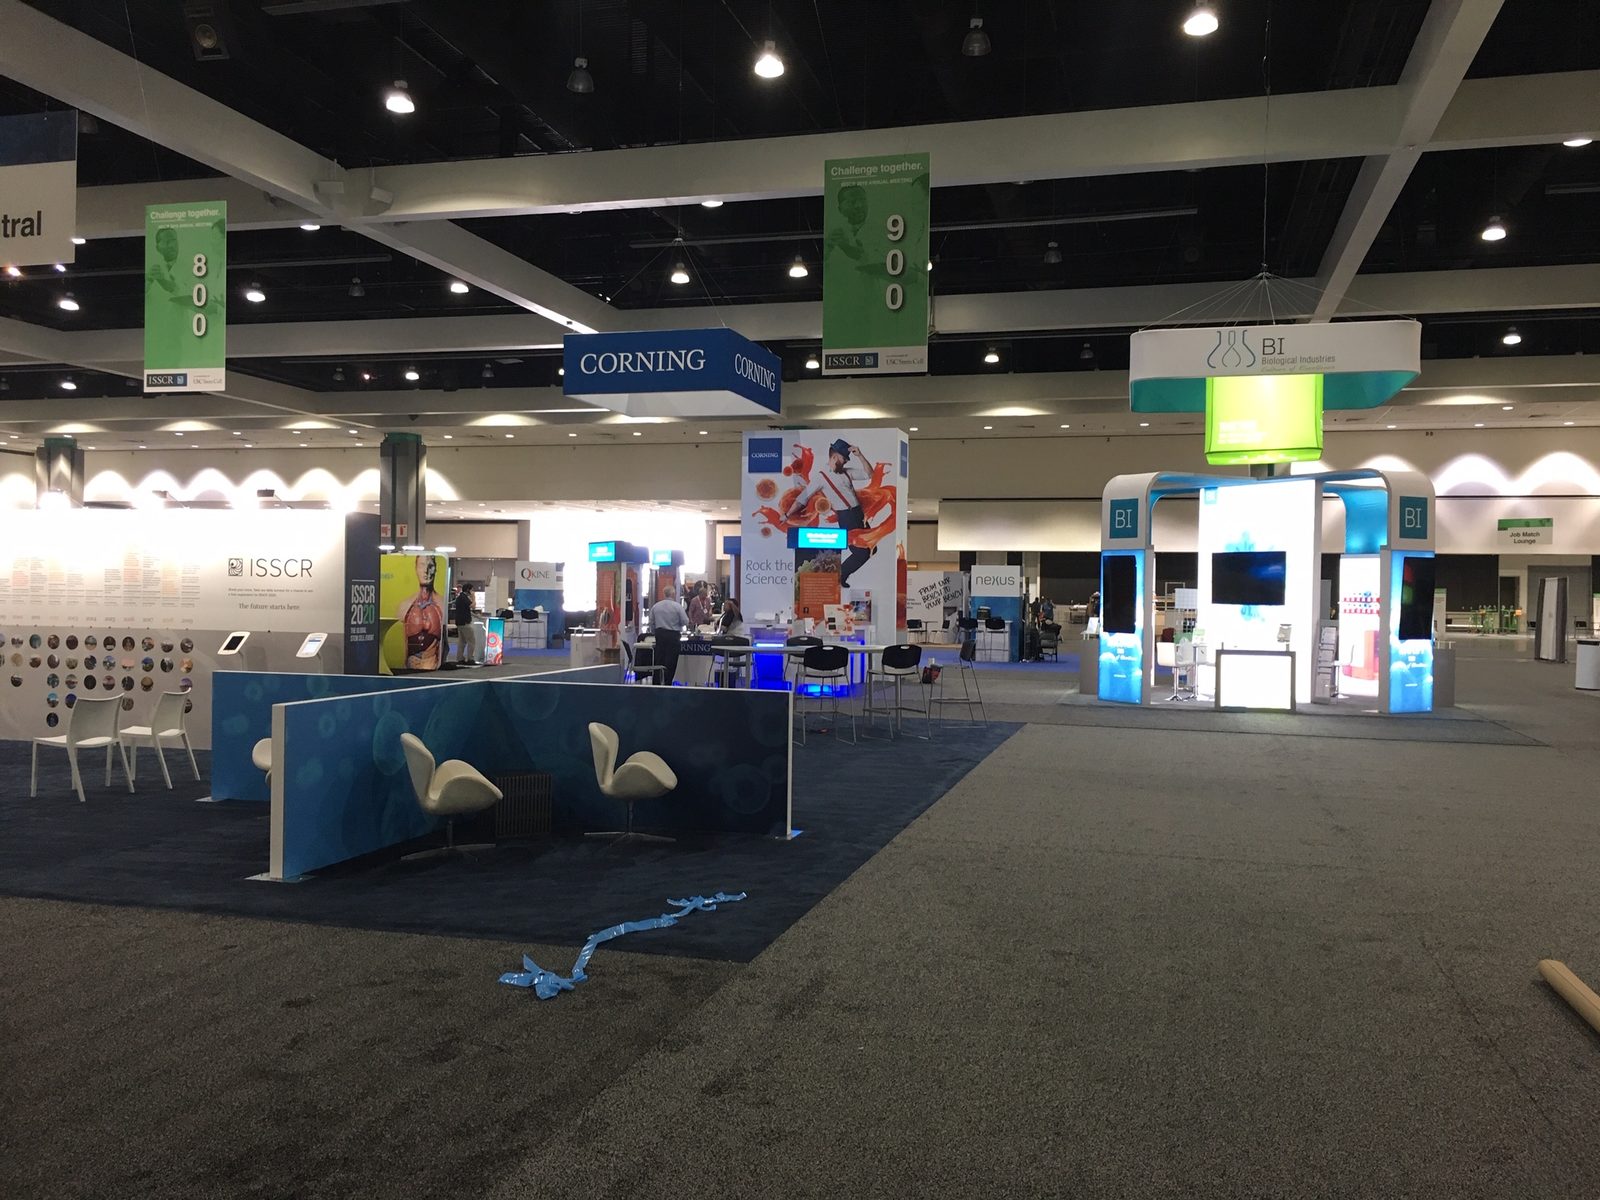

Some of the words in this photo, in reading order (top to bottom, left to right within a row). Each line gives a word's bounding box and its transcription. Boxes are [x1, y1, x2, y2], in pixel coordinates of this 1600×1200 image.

[831, 165, 878, 176] Challenge
[880, 162, 924, 174] together.
[150, 210, 187, 220] Challenge
[187, 208, 220, 219] together.
[1, 210, 42, 238] tral
[885, 214, 905, 310] 900
[192, 253, 207, 337] 800
[1262, 338, 1285, 355] BI
[580, 349, 706, 374] CORNING
[828, 356, 860, 366] ISSCR
[1261, 356, 1298, 365] Biological
[1299, 354, 1336, 364] Industries
[148, 375, 174, 385] ISSCR
[735, 353, 776, 392] CORNING
[1115, 509, 1133, 528] BI
[1405, 507, 1422, 528] BI
[250, 558, 313, 578] ISSCR
[746, 560, 772, 571] Rock
[745, 573, 788, 585] Science
[975, 575, 1015, 586] nexus
[351, 584, 376, 604] ISSCR
[250, 603, 268, 611] future
[286, 604, 300, 612] here
[350, 604, 375, 625] 2020
[680, 643, 711, 652] RNING
